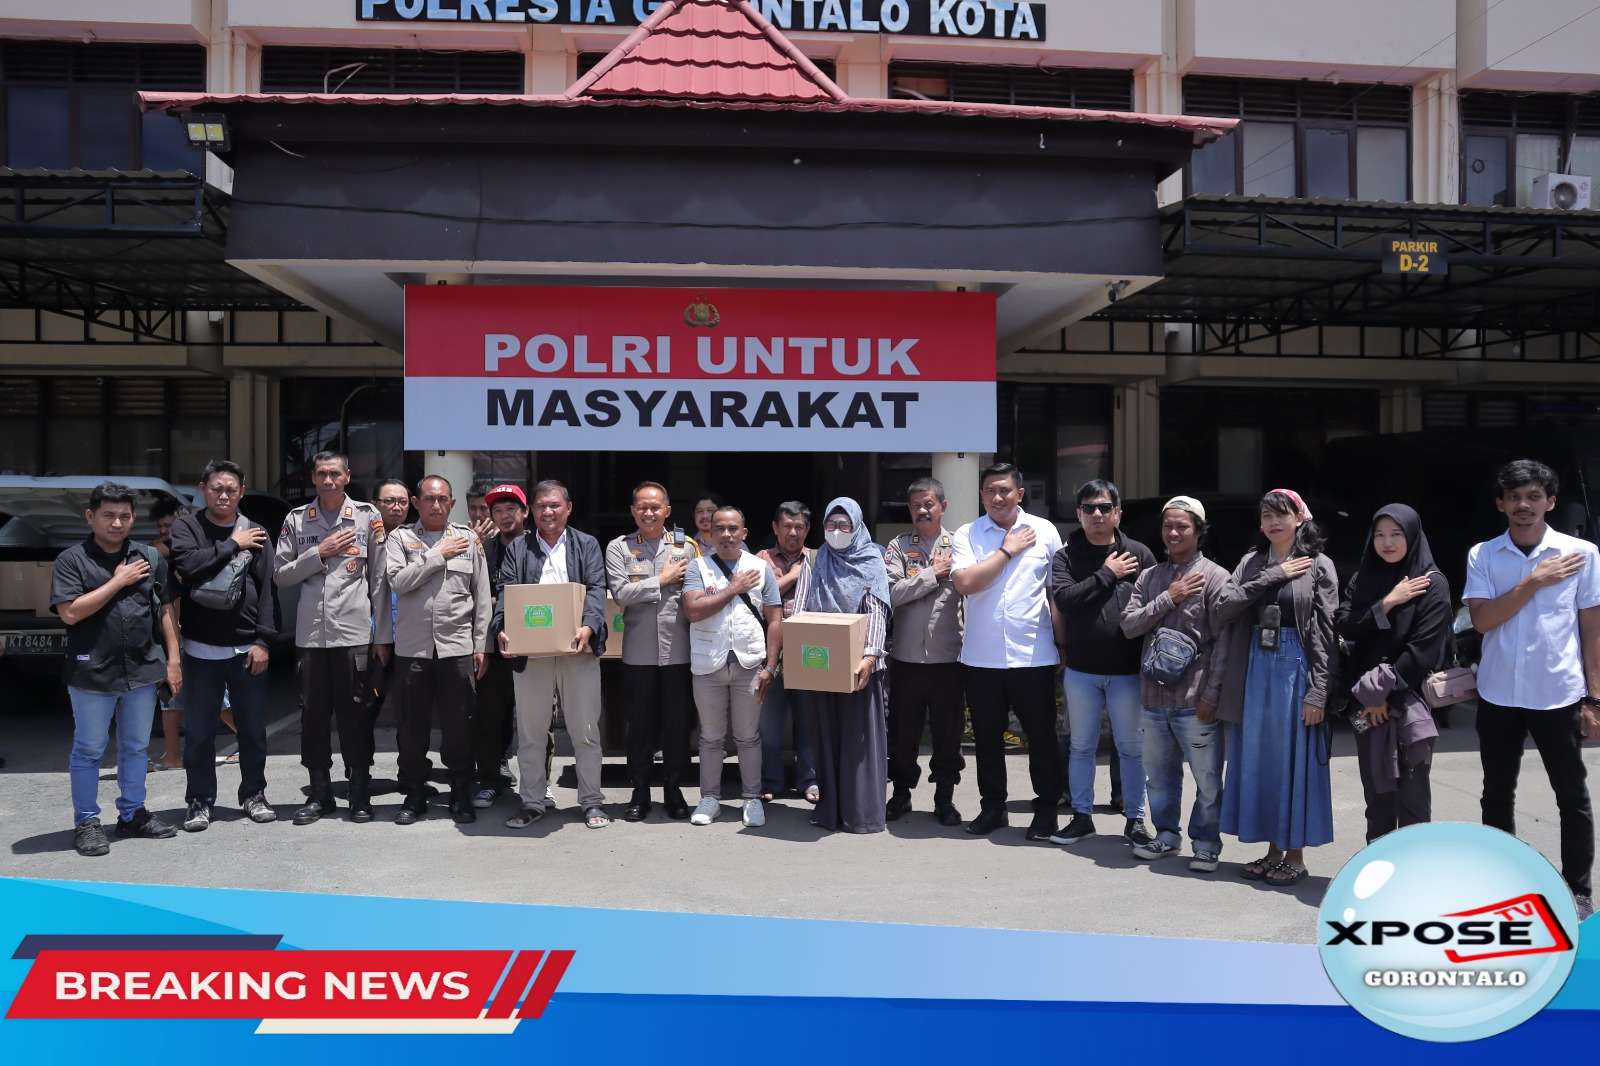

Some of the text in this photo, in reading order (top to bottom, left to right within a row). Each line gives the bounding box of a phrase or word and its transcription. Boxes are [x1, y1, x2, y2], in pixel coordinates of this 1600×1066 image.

[929, 0, 1039, 39] KOTA
[1391, 240, 1438, 253] PARKIR
[1400, 254, 1429, 272] D-2
[483, 333, 921, 376] POLRI UNTUK
[486, 388, 920, 429] MASYARAKAT
[25, 635, 53, 648] 8484
